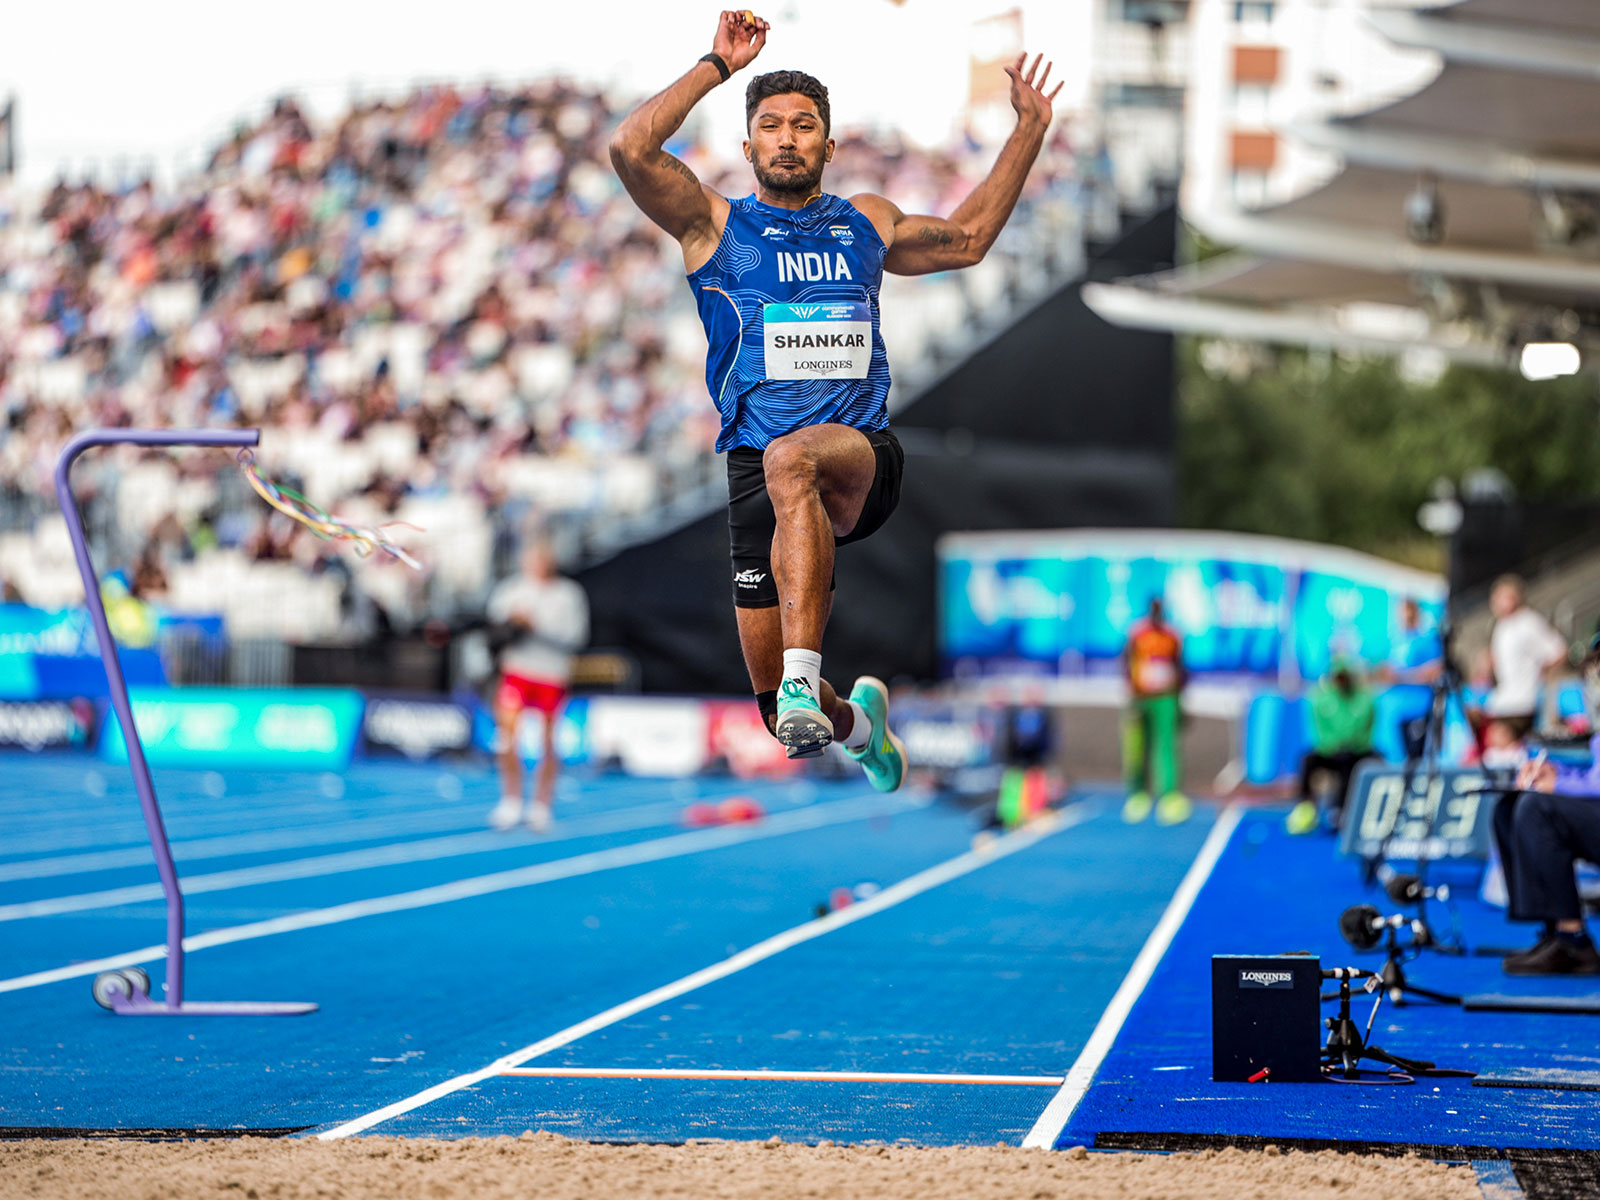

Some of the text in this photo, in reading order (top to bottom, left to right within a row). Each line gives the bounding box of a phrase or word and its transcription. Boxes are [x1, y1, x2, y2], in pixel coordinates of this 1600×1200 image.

[777, 252, 852, 282] INDIA
[774, 334, 865, 348] SHANKAR
[794, 360, 853, 370] LONGINES
[733, 570, 766, 582] JSW
[1241, 971, 1292, 982] LONGINES
